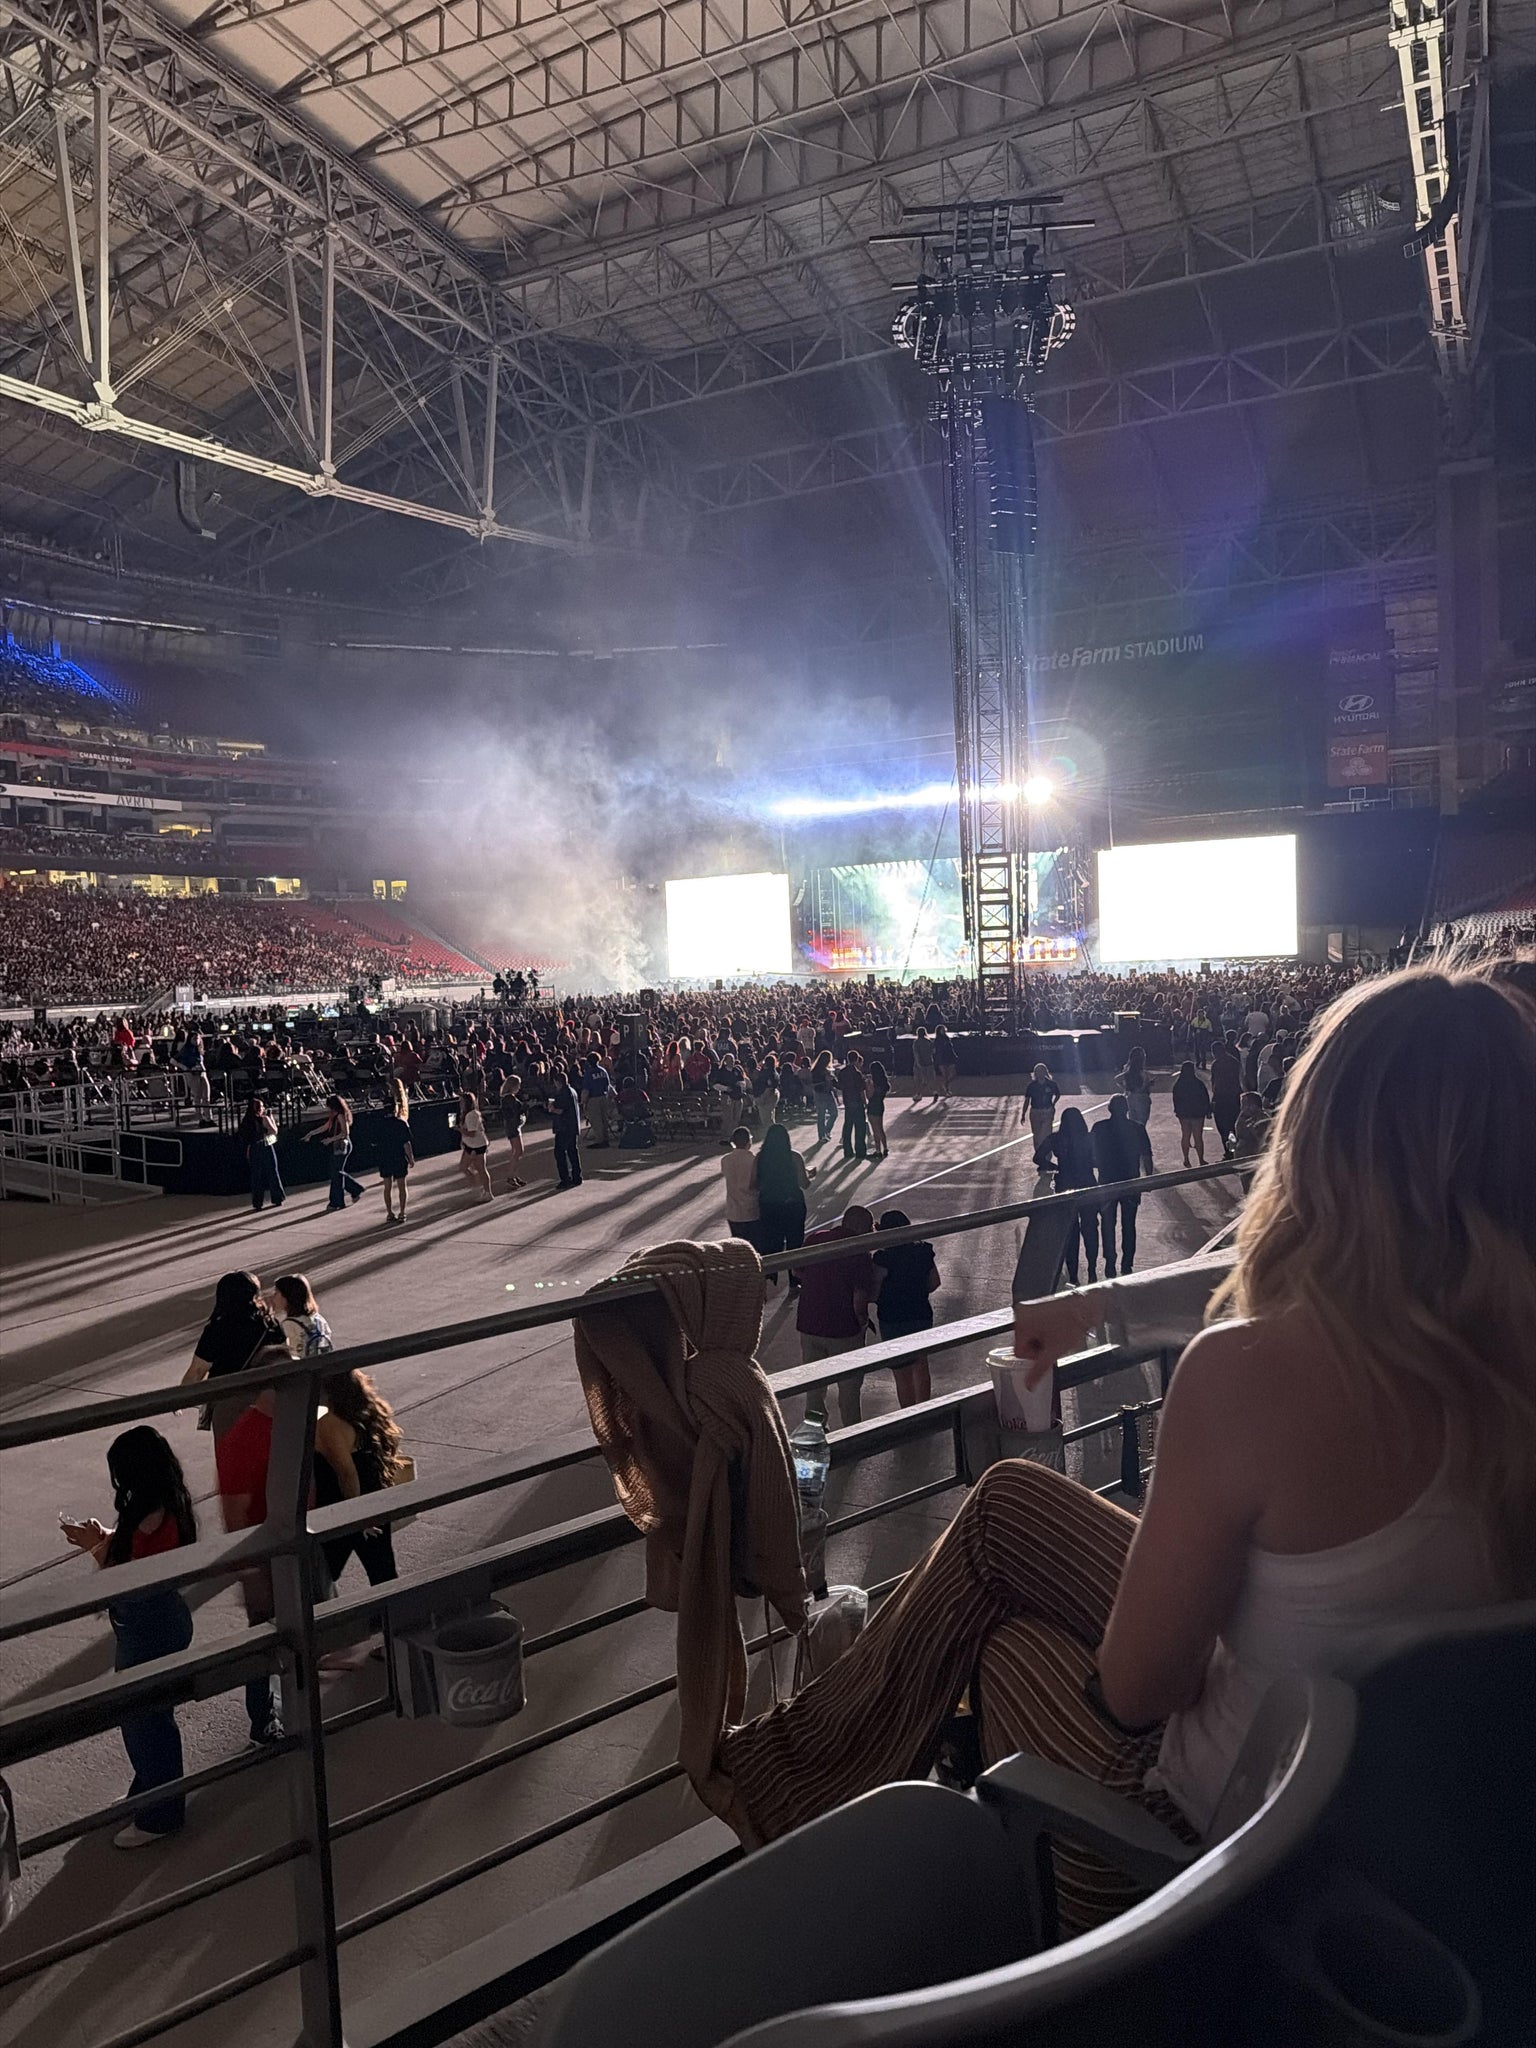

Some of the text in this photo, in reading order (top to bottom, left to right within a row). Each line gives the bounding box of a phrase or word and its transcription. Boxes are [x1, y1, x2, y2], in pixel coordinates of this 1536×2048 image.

[1123, 634, 1204, 659] STADIUM
[1333, 711, 1380, 724] HYUNDAI
[643, 993, 651, 1002] G
[623, 1024, 630, 1038] P
